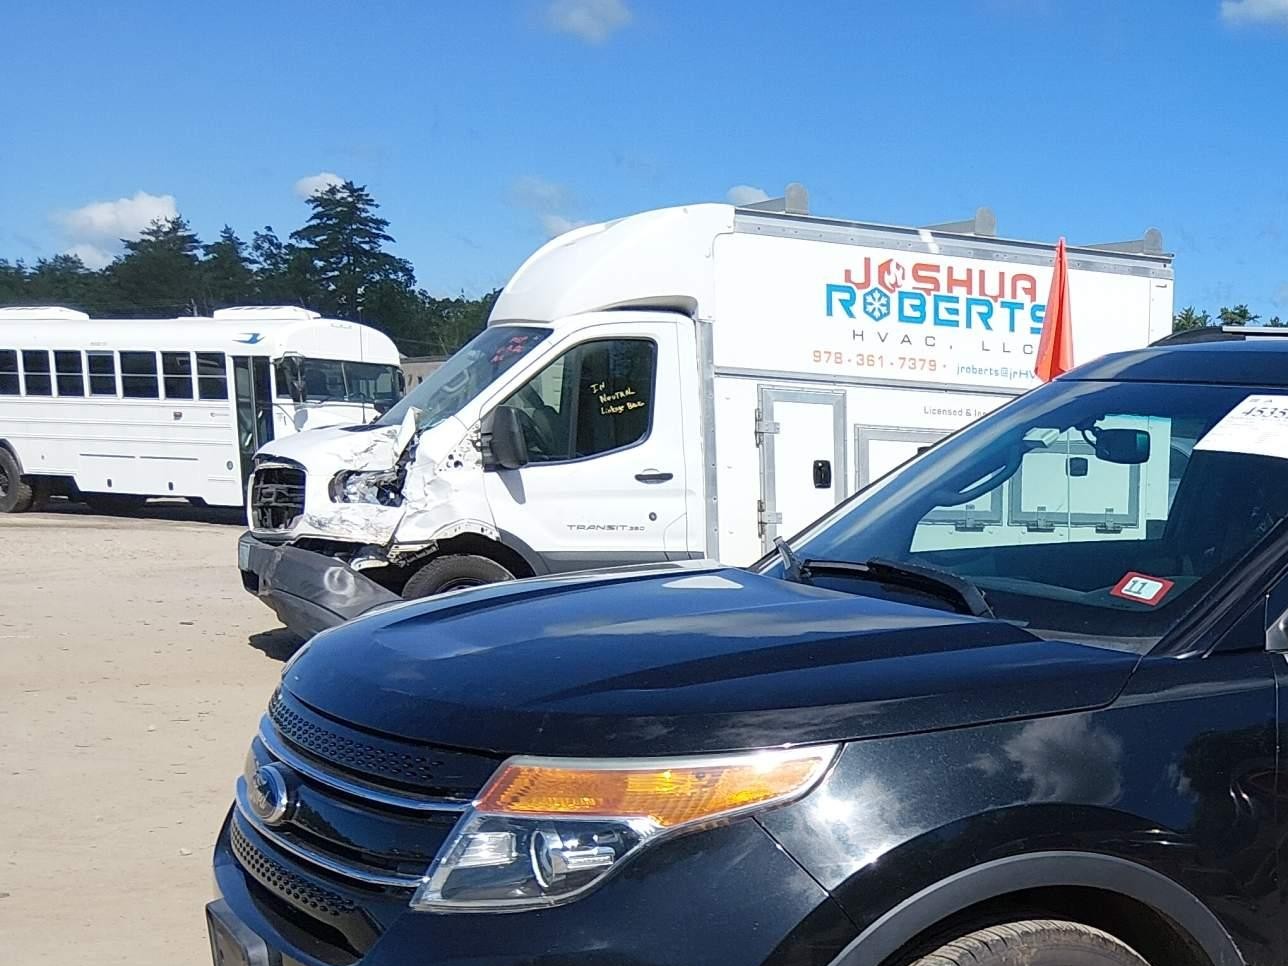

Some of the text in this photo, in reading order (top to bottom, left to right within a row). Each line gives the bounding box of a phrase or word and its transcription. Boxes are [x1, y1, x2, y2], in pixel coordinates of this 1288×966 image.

[844, 256, 1037, 302] JOSHUA
[826, 283, 1046, 335] ROBERTS
[981, 340, 1034, 355] LLC
[924, 406, 963, 417] Licensed
[966, 408, 972, 416] &
[1124, 580, 1148, 595] 11
